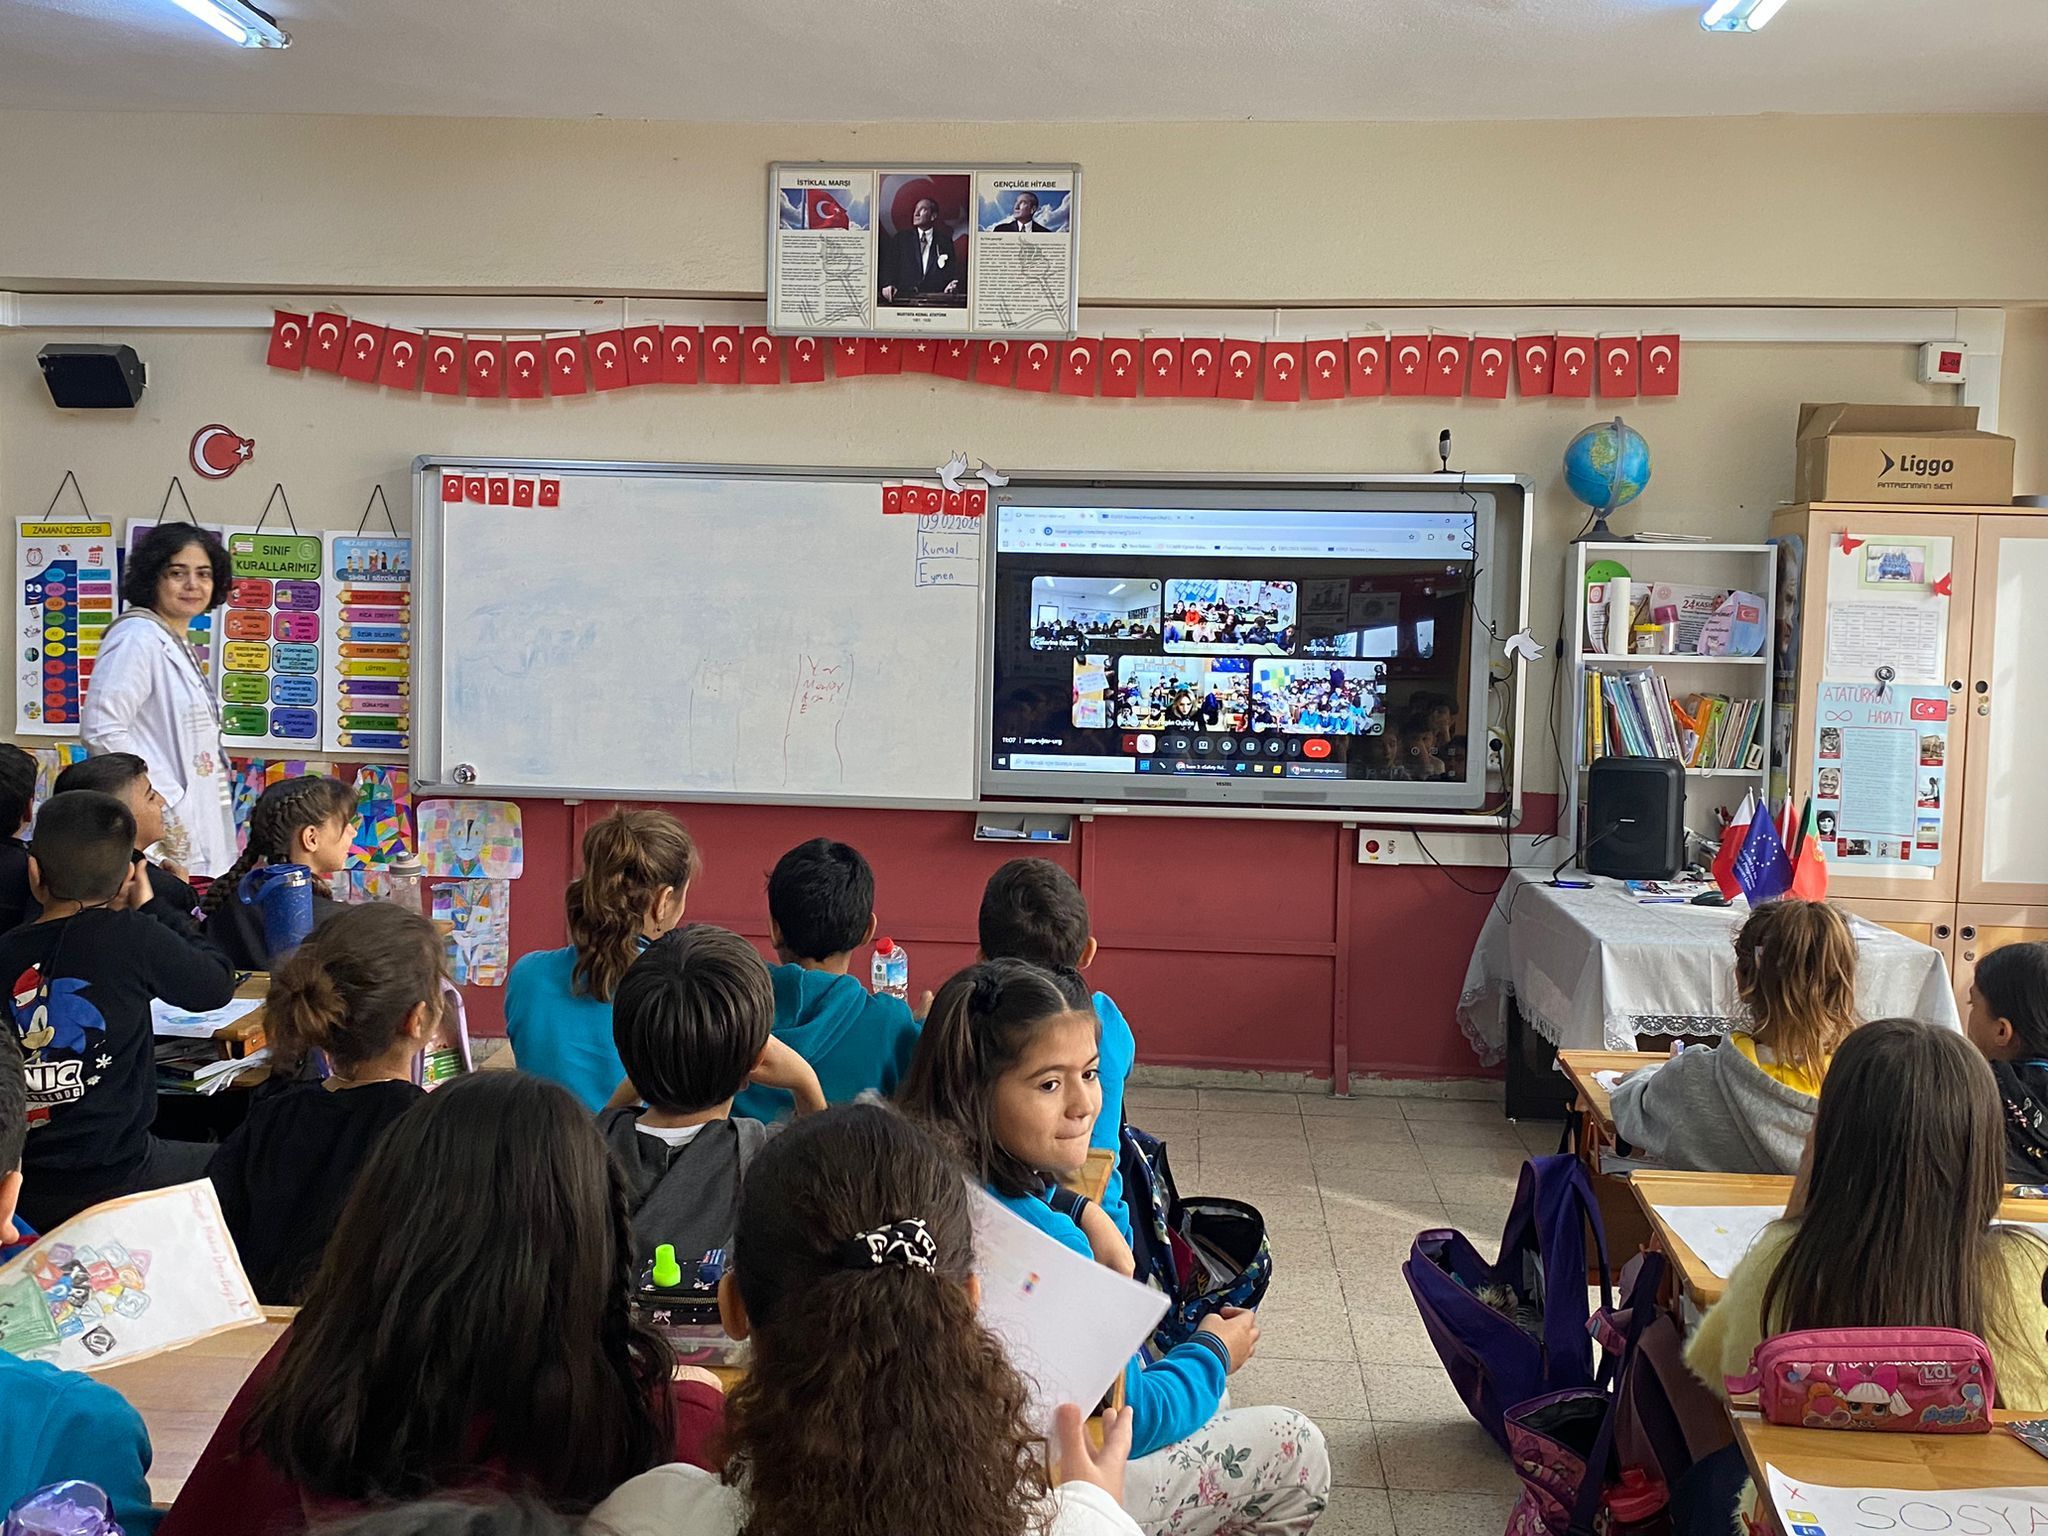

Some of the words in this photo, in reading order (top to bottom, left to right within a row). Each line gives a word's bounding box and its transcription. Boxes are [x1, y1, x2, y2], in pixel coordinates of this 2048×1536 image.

[797, 178, 827, 187] İSTİKLAL
[829, 179, 851, 188] MARŞI
[993, 180, 1029, 189] GENÇLİĞE
[1030, 180, 1057, 188] HİTABE
[1900, 454, 1954, 476] Liggo
[1877, 481, 1932, 489] ANTRENMAN
[1933, 482, 1953, 490] SETİ
[32, 526, 62, 534] ZAMAN
[262, 545, 291, 556] SINIF
[922, 536, 959, 556] Kumsal
[236, 560, 317, 573] KURALLARIMIZ
[919, 562, 954, 583] Eymen
[1682, 599, 1695, 610] 24
[365, 664, 387, 672] LÜTFEN
[1867, 709, 1904, 726] HAYATI
[1001, 736, 1017, 744] 11:07
[24, 1065, 78, 1092] NIC
